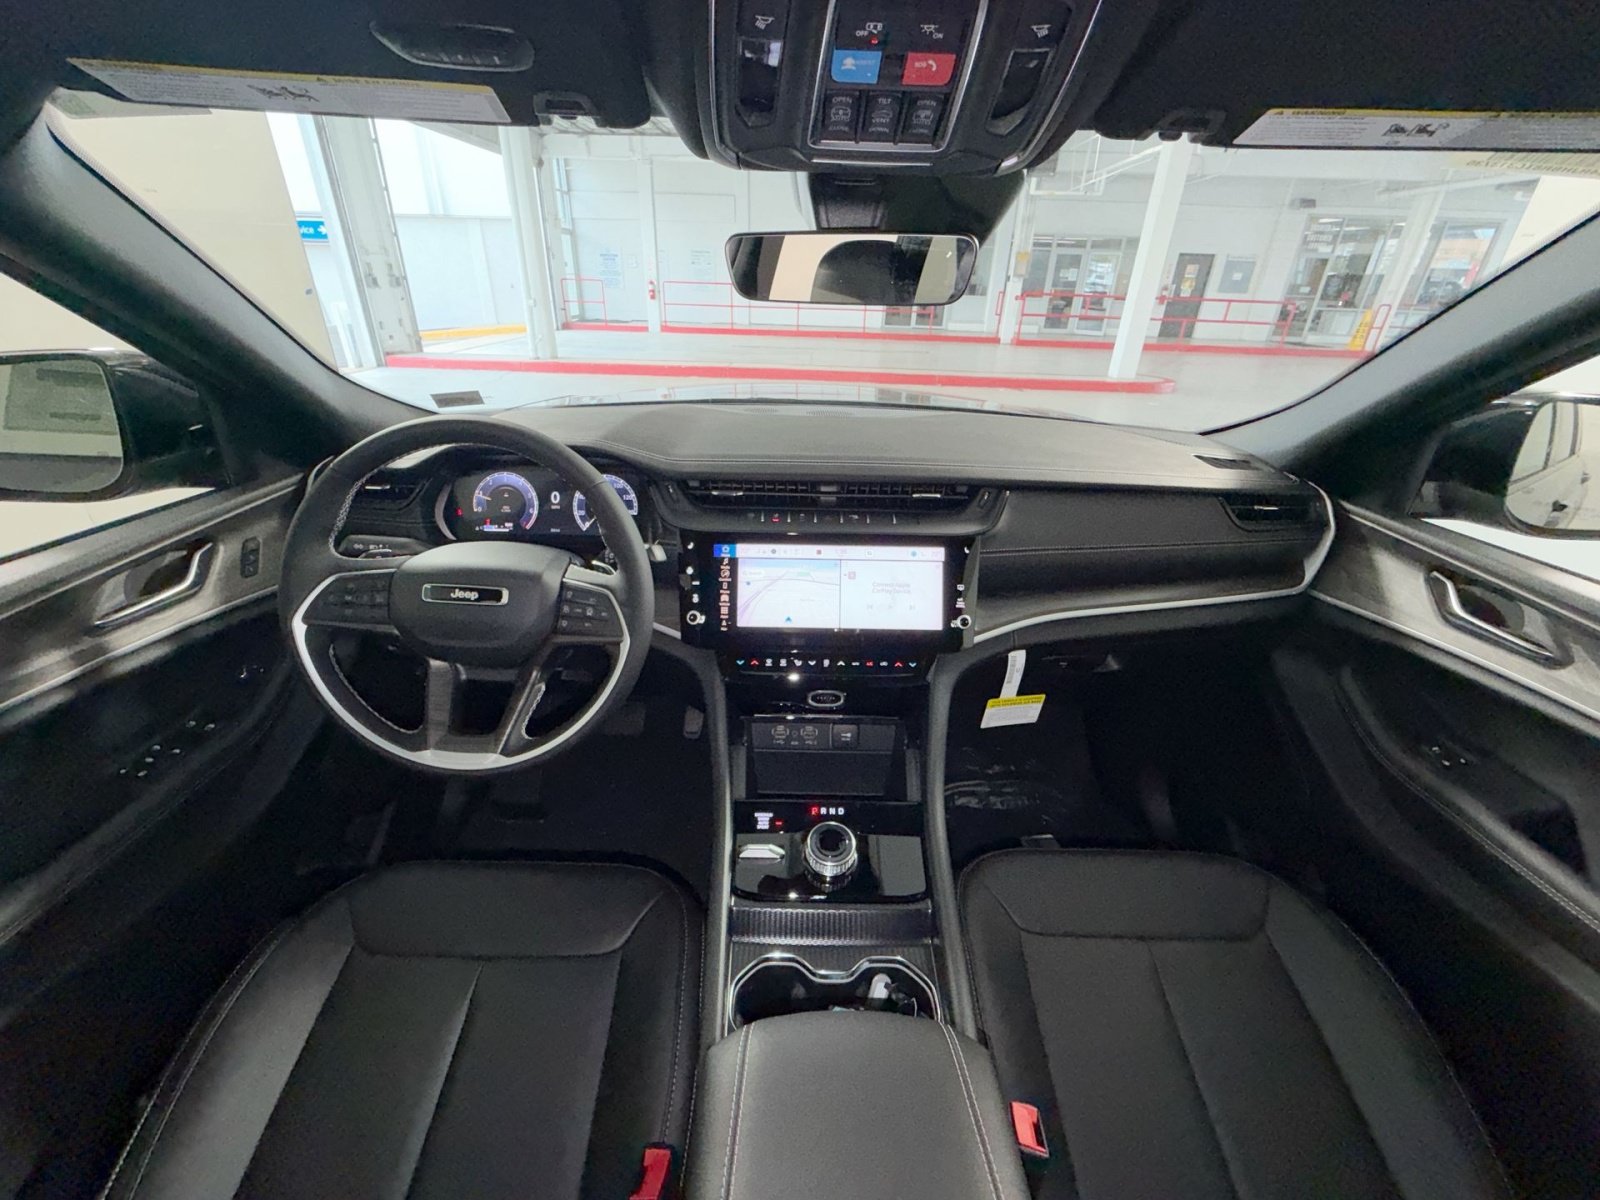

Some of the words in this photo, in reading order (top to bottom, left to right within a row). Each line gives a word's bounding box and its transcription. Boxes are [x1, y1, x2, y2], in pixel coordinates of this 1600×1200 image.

[832, 96, 853, 104] OPEN
[550, 490, 561, 504] 0
[450, 588, 479, 601] Jeep
